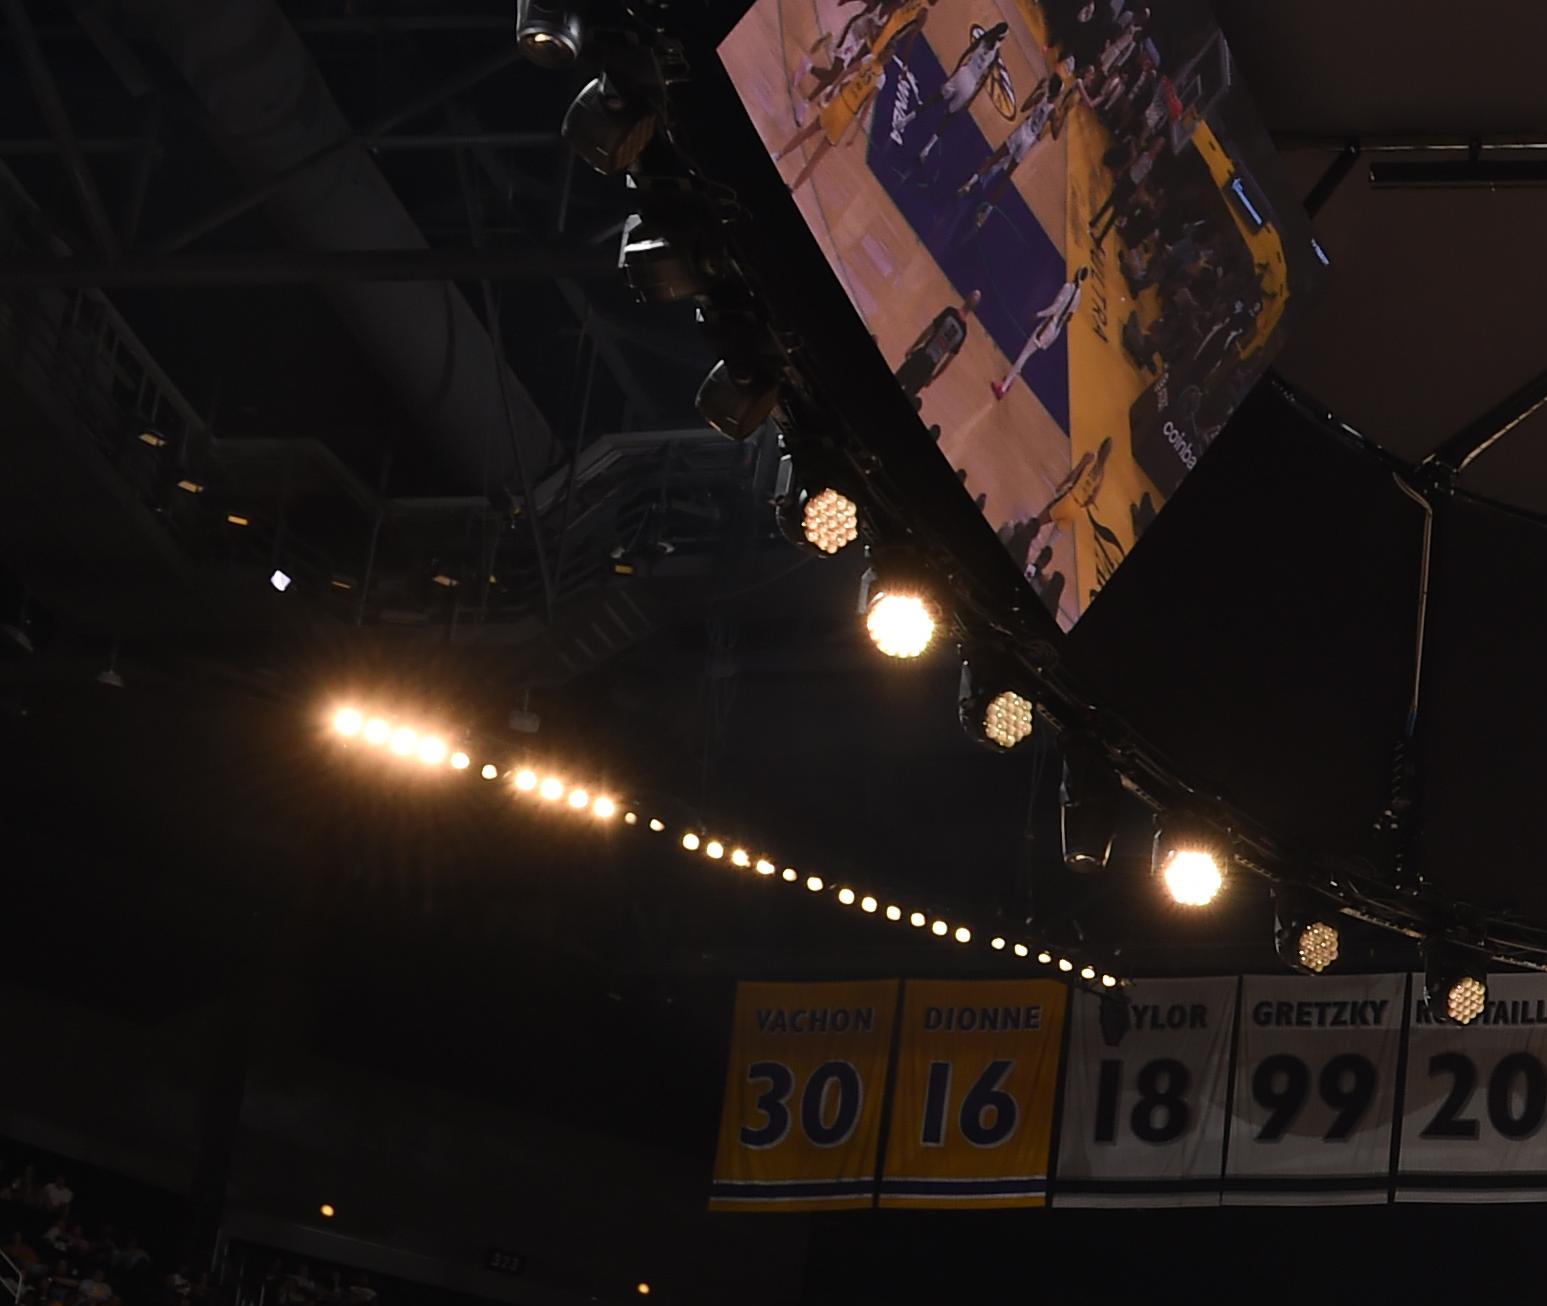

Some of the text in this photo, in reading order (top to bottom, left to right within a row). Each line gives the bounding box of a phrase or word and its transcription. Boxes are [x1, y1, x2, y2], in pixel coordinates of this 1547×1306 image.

[756, 1006, 875, 1034] VACHON
[924, 1005, 1042, 1032] DIONNE
[1252, 1000, 1388, 1027] GRETZKY
[739, 1060, 866, 1151] 30
[920, 1060, 1021, 1149] 16
[1094, 1057, 1193, 1146] 18
[1251, 1052, 1379, 1144] 99
